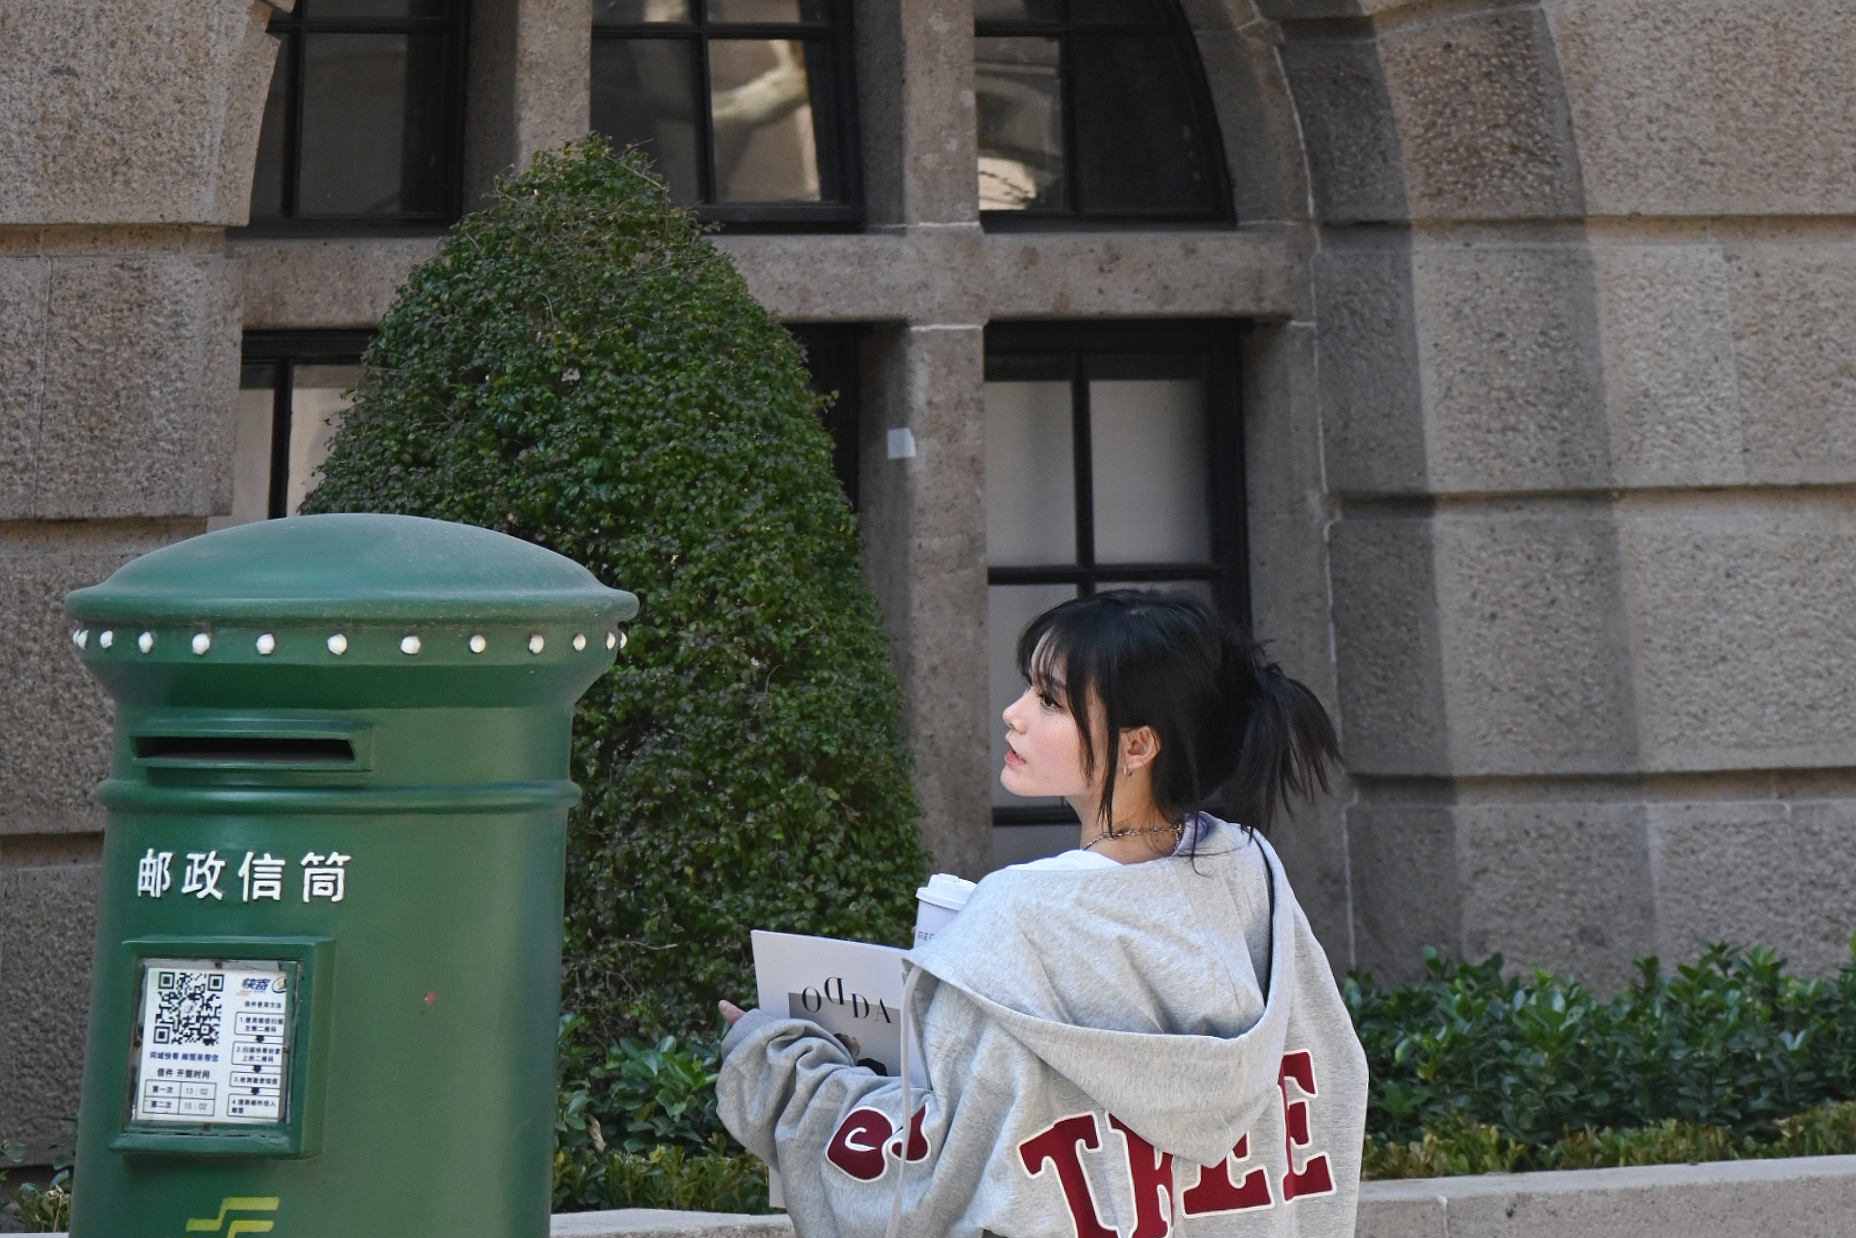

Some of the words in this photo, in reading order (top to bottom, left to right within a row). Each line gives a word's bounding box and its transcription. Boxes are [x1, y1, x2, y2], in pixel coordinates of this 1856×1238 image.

[137, 848, 352, 903] 邮政信筒
[157, 1067, 174, 1077] 信件
[176, 1068, 210, 1080] 开筒时间
[152, 1085, 174, 1094] 第一次
[150, 1100, 173, 1109] 第二次
